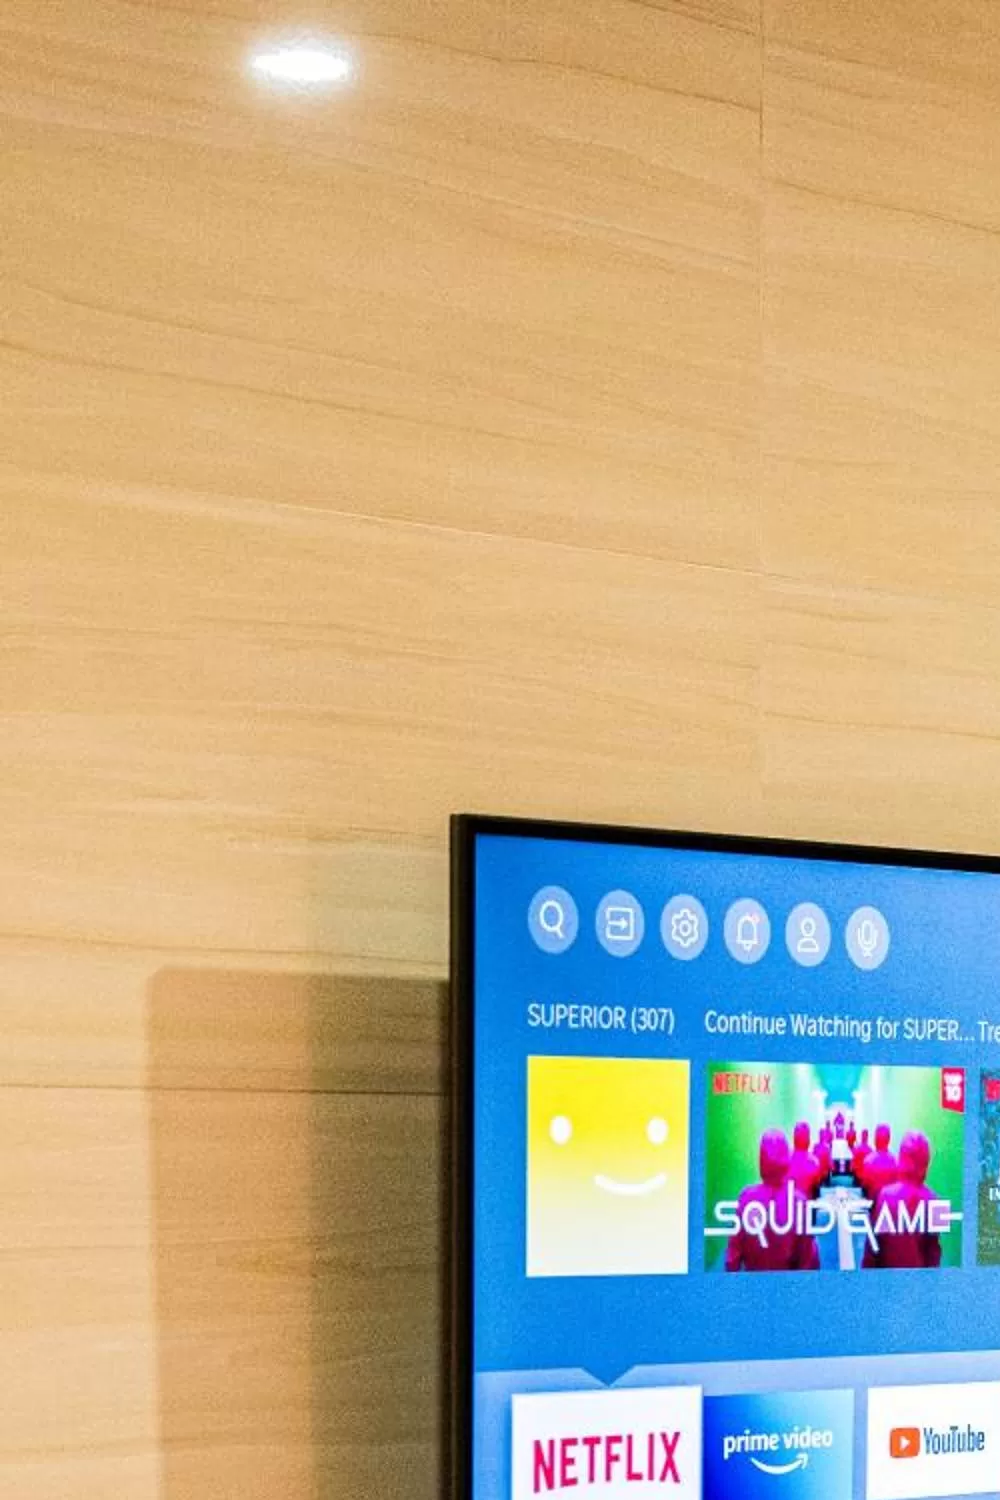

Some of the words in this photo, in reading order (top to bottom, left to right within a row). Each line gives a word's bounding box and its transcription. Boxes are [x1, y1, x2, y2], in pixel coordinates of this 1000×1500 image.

[527, 1003, 626, 1029] SUPERIOR
[631, 1007, 675, 1035] (307)
[704, 1010, 786, 1036] Continue
[789, 1014, 872, 1043] Watching
[876, 1017, 898, 1038] for
[713, 1072, 771, 1094] NETFLIX
[704, 1180, 836, 1249] SQUID
[844, 1199, 964, 1252] GAME
[722, 1429, 779, 1460] prime
[783, 1425, 833, 1449] video
[923, 1424, 985, 1455] YouTube
[533, 1431, 682, 1494] NETFLIX
